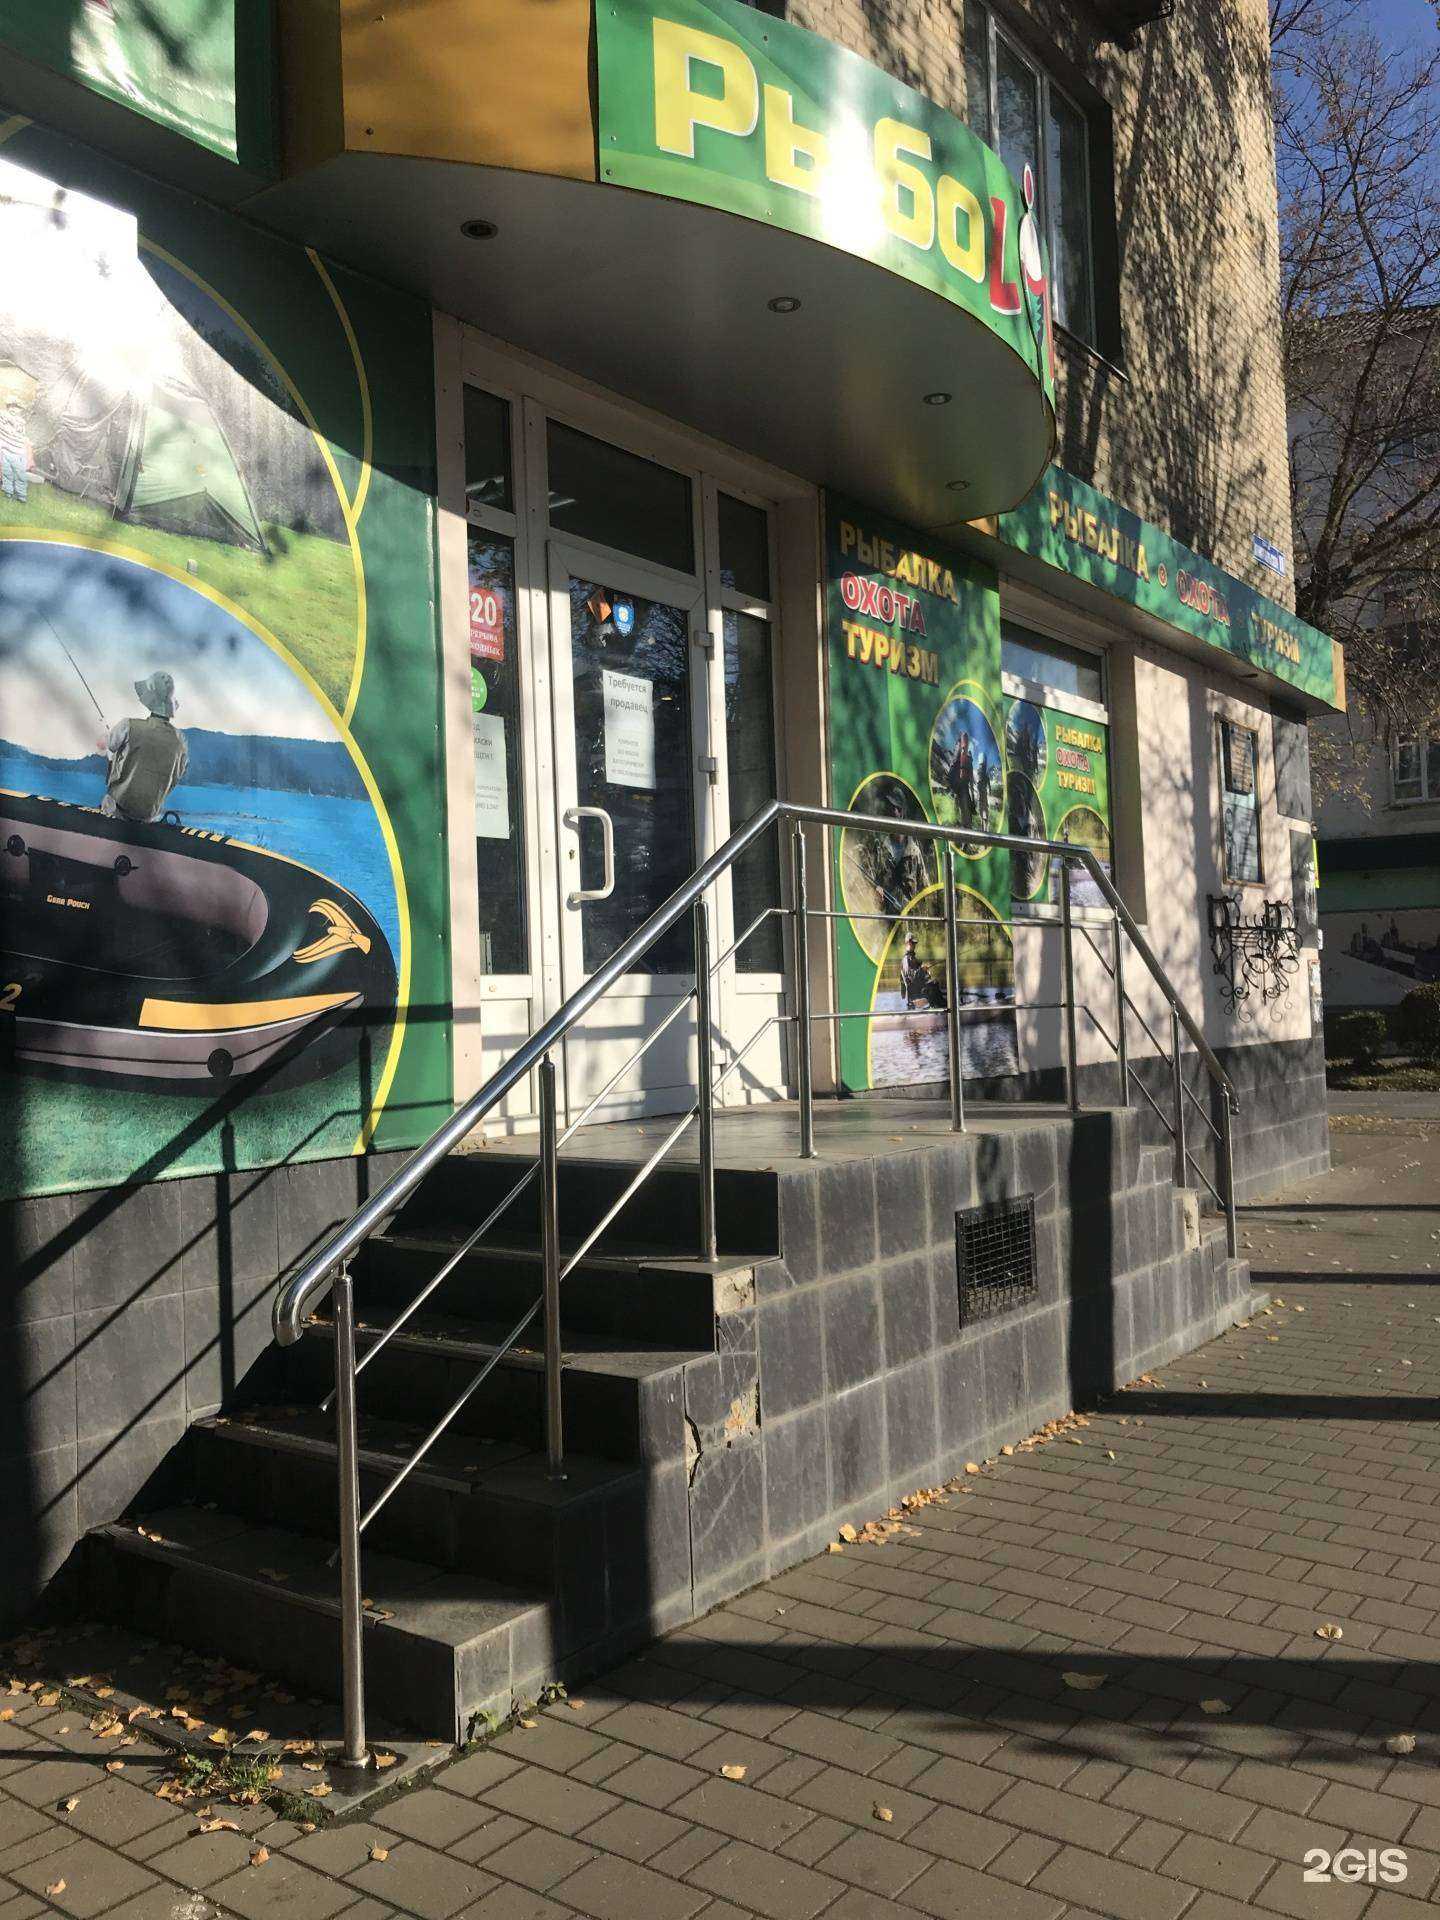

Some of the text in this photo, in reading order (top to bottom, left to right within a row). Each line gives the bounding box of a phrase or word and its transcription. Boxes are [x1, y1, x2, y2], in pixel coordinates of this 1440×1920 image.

[840, 520, 960, 607] РЫБАЛКА
[1049, 491, 1151, 583] РЫБАЛКА
[1176, 568, 1231, 627] ОХОТА
[840, 570, 928, 637] ОХОТА
[841, 619, 940, 687] ТУРИЗМ
[608, 675, 647, 693] Требуется
[610, 697, 649, 714] продавец
[1055, 725, 1103, 753] РЫБАЛКА
[1056, 747, 1090, 772] ОХОТА
[1056, 771, 1096, 795] ТУРИЗМ
